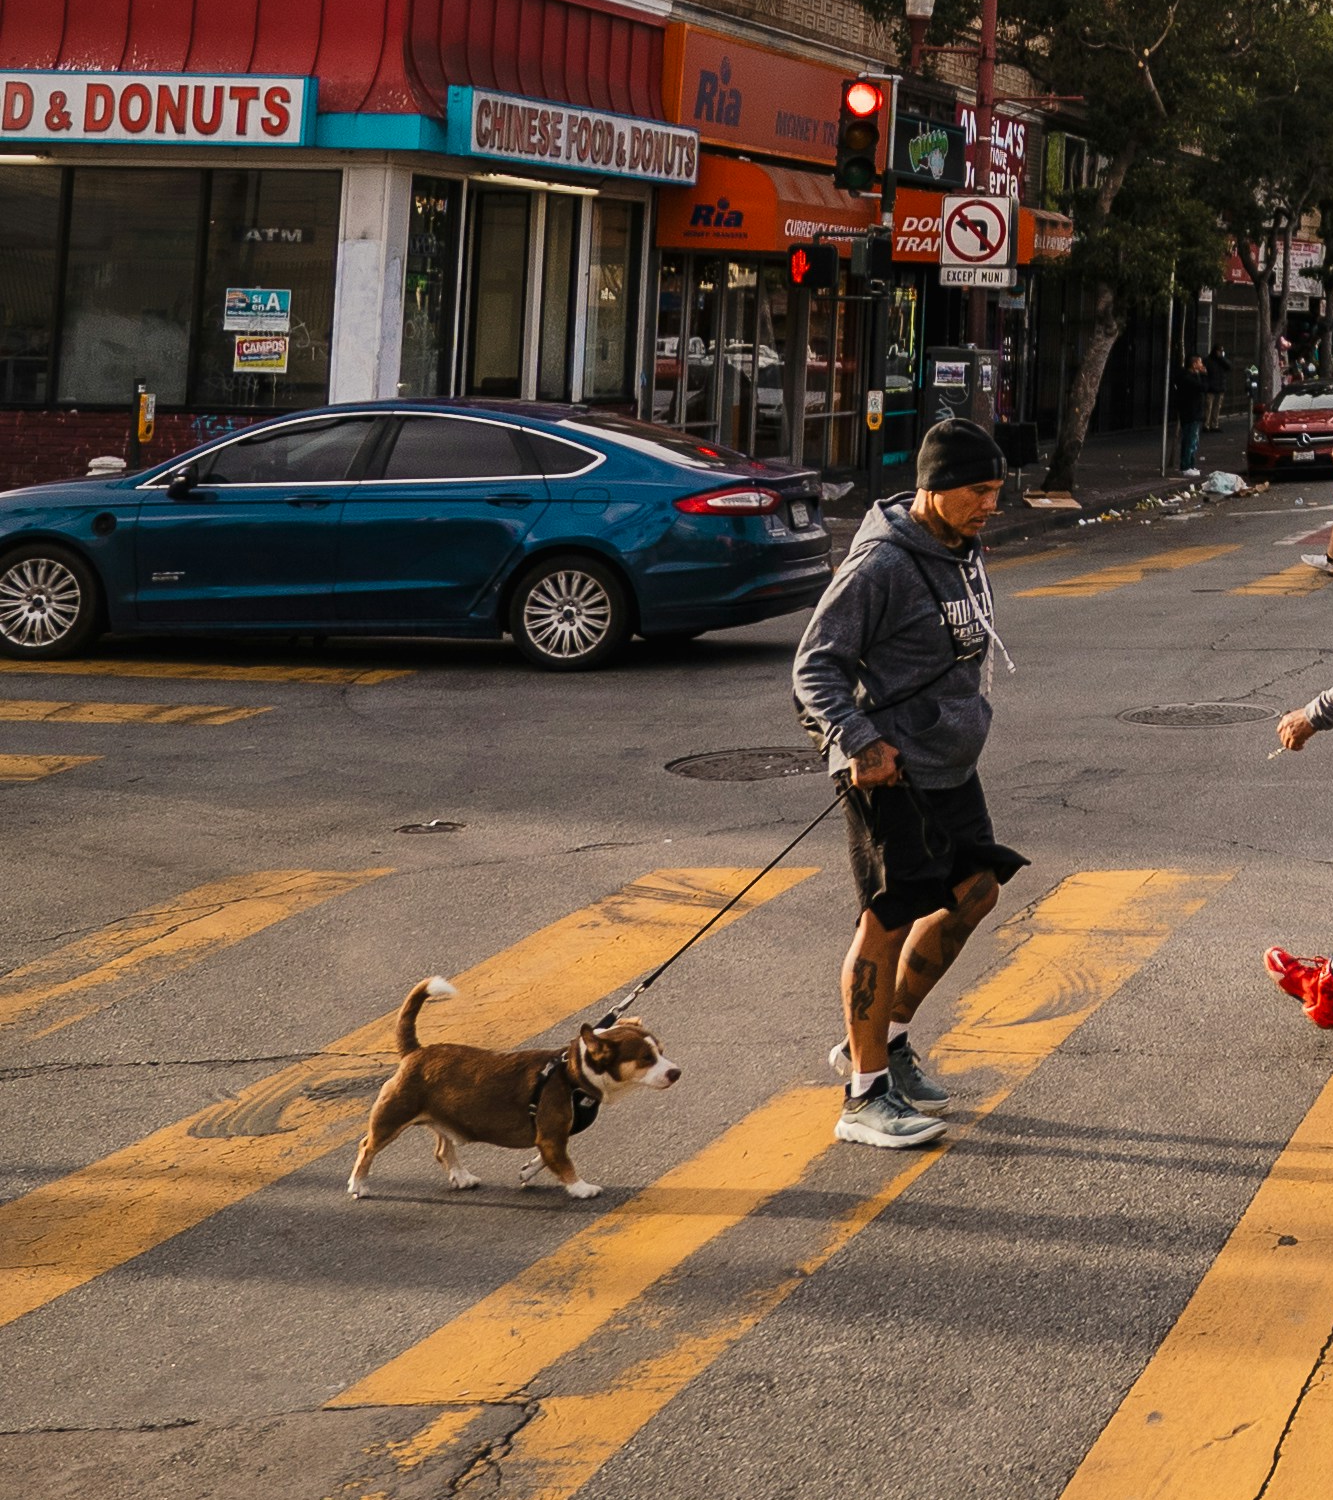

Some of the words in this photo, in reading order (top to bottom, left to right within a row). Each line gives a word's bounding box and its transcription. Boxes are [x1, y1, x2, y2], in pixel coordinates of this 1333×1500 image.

[694, 56, 742, 127] Ria
[44, 90, 73, 133] &
[83, 83, 291, 137] DONUTS
[475, 98, 564, 158] CHINESE
[566, 113, 615, 167] FOOD
[616, 131, 627, 168] &
[629, 126, 697, 178] DONUTS
[690, 197, 744, 228] Ria
[245, 228, 302, 243] ATM
[981, 271, 1003, 283] MUNI
[252, 303, 265, 311] en
[266, 293, 281, 311] A
[242, 339, 286, 355] CAMPOS
